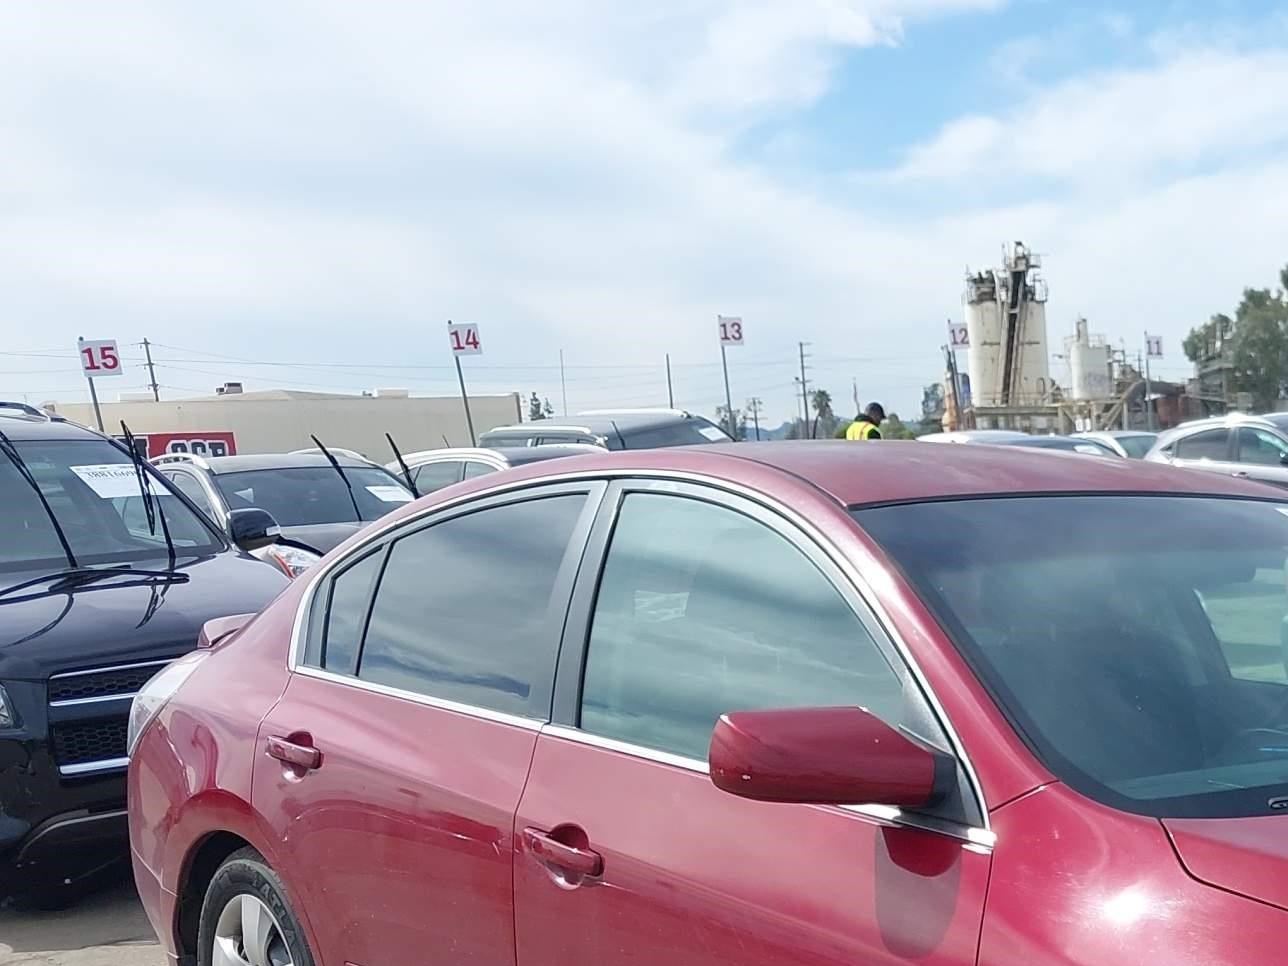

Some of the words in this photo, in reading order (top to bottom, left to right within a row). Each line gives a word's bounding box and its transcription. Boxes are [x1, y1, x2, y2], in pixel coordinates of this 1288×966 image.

[450, 328, 480, 351] 14
[720, 322, 743, 341] 13
[950, 328, 969, 345] 12
[1146, 340, 1163, 355] 11
[81, 346, 118, 371] 15
